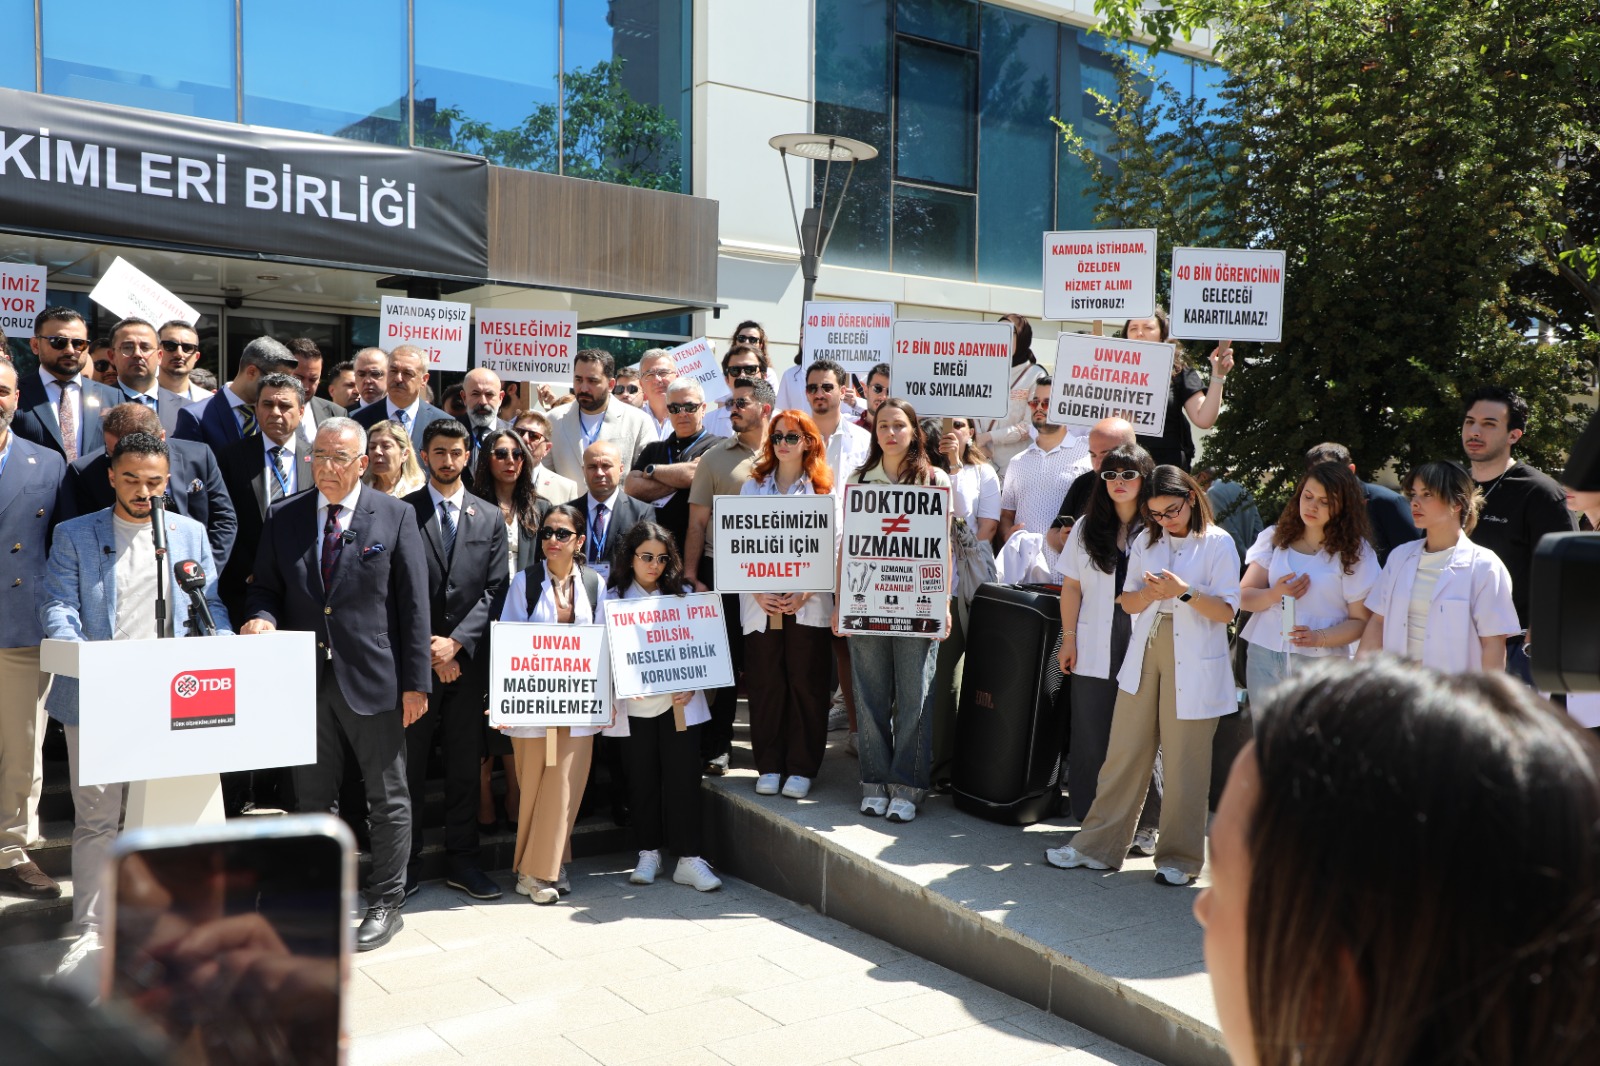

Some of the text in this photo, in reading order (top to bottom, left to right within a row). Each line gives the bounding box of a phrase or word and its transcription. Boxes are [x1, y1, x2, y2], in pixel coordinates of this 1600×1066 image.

[0, 127, 416, 229] KİMLERİ BİRLİĞİ
[1052, 241, 1147, 255] KAMUDA İSTİHDAM,
[1077, 260, 1120, 273] ÖZELDEN
[1177, 262, 1280, 283] 40 BİN ÖĞRENCİNİN
[1065, 278, 1132, 291] HİZMET ALIMI
[1071, 297, 1125, 309] İSTİYORUZ!
[1202, 286, 1252, 304] GELECEĞİ
[386, 304, 466, 322] VATANDAŞ DİŞSİZ
[807, 313, 890, 328] 40 BİN ÖĞRENCİNİN
[1184, 308, 1268, 326] KARARTILAMAZ!
[388, 322, 462, 342] DİŞHEKİMİ
[480, 320, 572, 338] MESLEĞİMİZ
[827, 330, 868, 344] GELECEĞİ
[424, 346, 441, 362] İZ
[484, 339, 568, 357] TÜKENİYOR
[813, 349, 881, 361] KARARTILAMAZ!
[896, 337, 1007, 357] 12 BİN DUS ADAYININ
[1094, 347, 1142, 365] UNVAN
[481, 358, 570, 373] BİZ TÜKENİYORUZ!
[933, 360, 967, 376] EMEĞİ
[1071, 364, 1150, 387] DAĞITARAK
[905, 381, 992, 398] YOK SAYILAMAZ!
[1062, 382, 1154, 406] MAĞDURİYET
[1057, 400, 1156, 425] GİDERİLEMEZ!
[850, 490, 943, 515] DOKTORA
[721, 510, 828, 529] MESLEĞİMİZİN
[731, 535, 819, 557] BİRLİĞİ İÇİN
[848, 535, 942, 559] UZMANLIK
[740, 562, 810, 577] “ADALET”
[881, 564, 913, 573] UZMANLIK
[922, 566, 941, 579] DUS
[880, 574, 913, 582] SINAVIYLA
[874, 583, 914, 592] KAZANILIR!
[612, 604, 718, 626] TUK KARARI İPTAL
[532, 635, 580, 650] UNVAN
[646, 625, 694, 643] EDİLSİN,
[511, 653, 591, 672] DAĞITARAK
[626, 642, 716, 666] MESLEKİ BİRLİK
[503, 674, 597, 693] MAĞDURİYET
[640, 665, 708, 684] KORUNSUN!
[200, 677, 232, 691] TDB
[500, 696, 602, 714] GİDERİLEMEZ!
